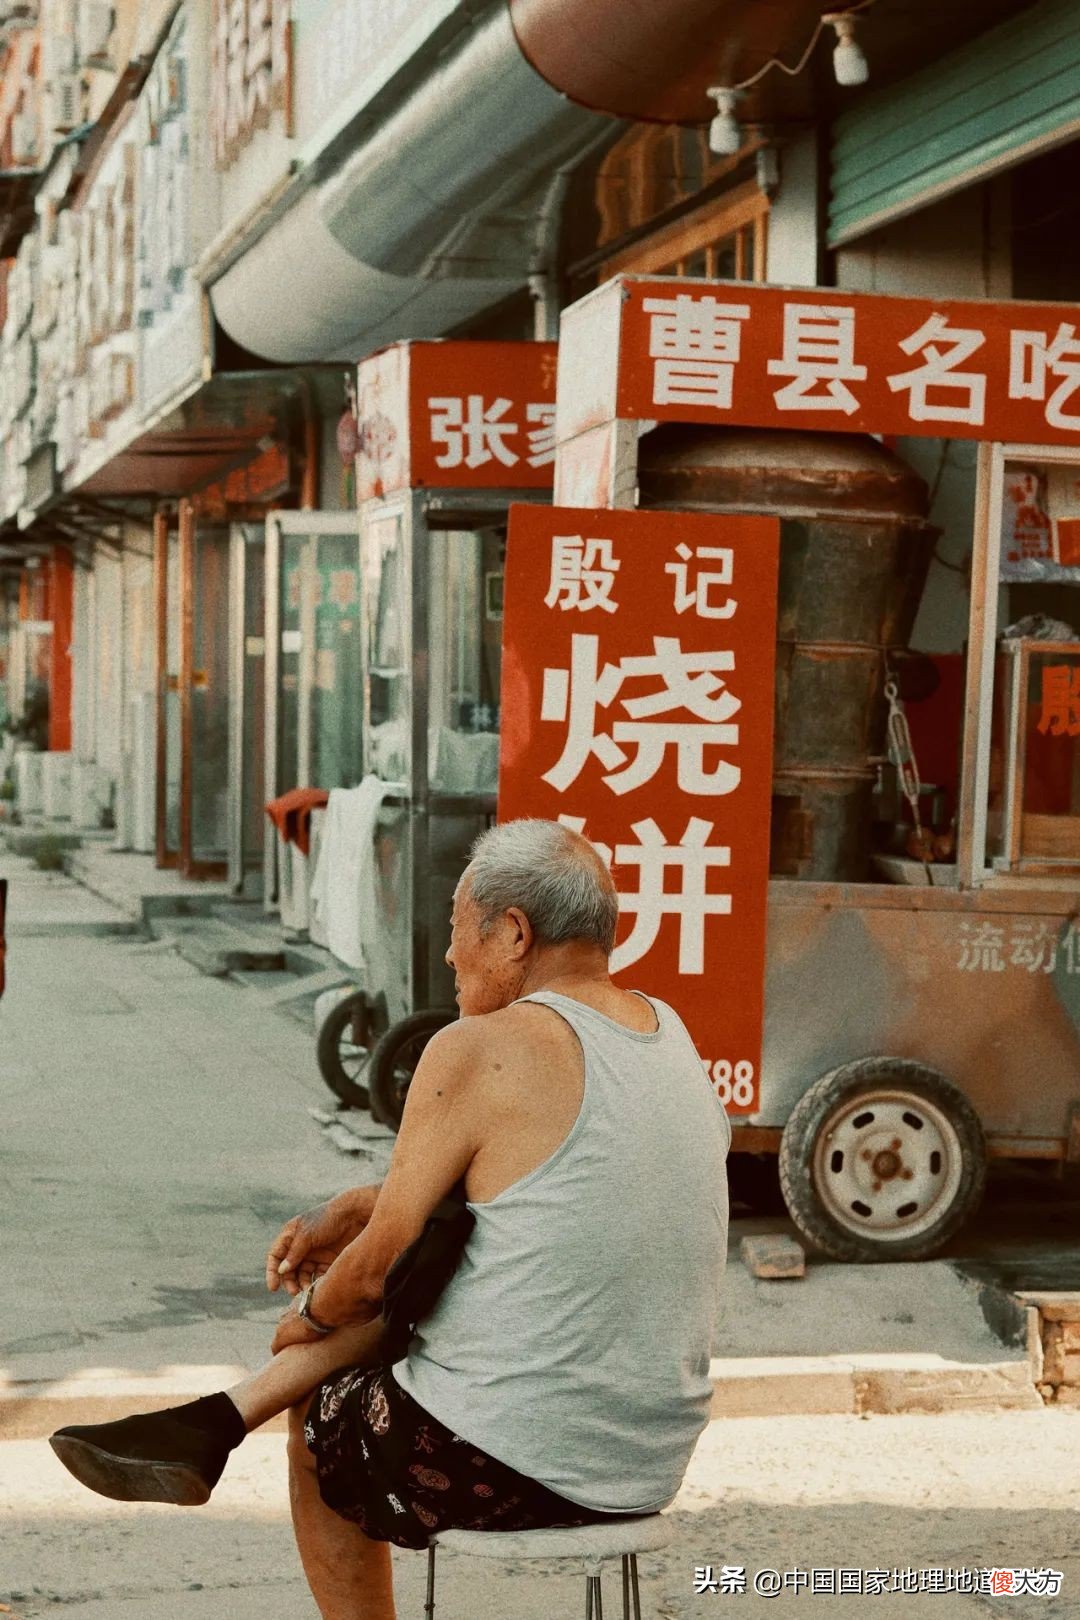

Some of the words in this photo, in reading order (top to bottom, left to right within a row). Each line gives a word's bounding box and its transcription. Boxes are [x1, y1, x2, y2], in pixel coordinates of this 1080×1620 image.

[643, 294, 1080, 432] 曹县名吃
[701, 1059, 754, 1107] 88
